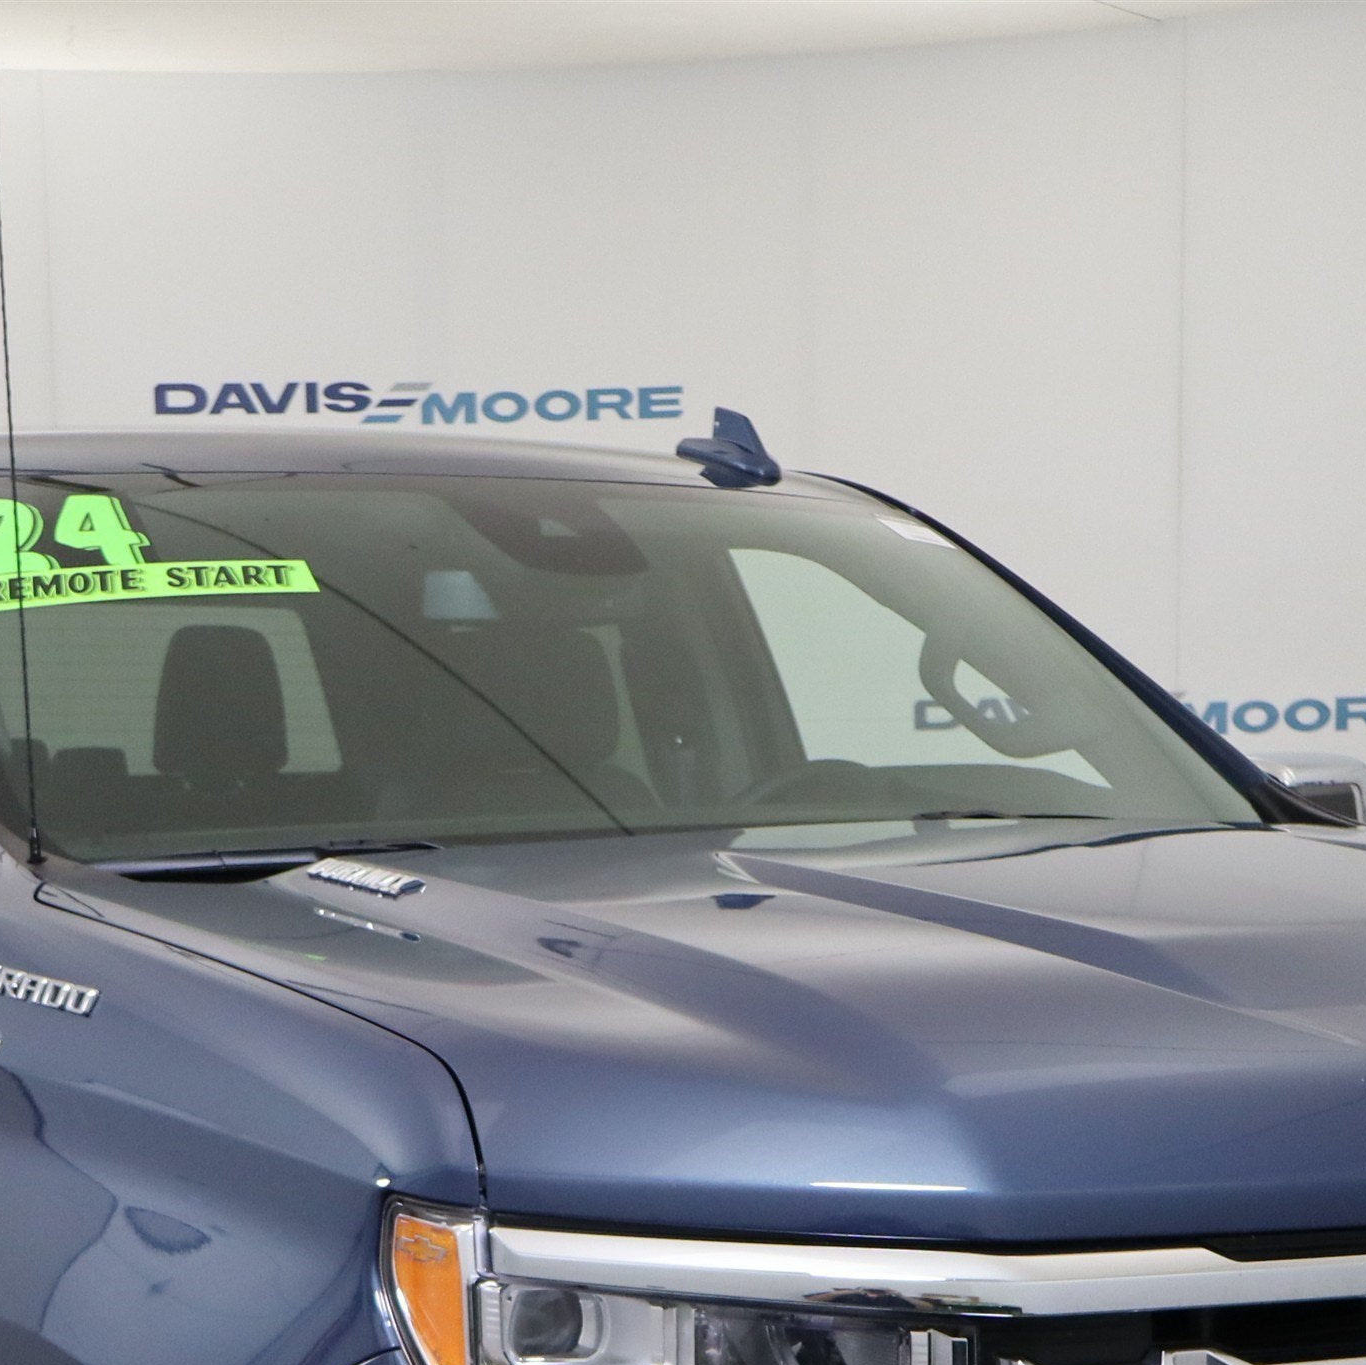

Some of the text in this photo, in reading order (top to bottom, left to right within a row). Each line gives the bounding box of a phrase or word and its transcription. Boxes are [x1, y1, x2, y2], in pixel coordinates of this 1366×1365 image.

[153, 381, 684, 425] DAVIS MOORE
[166, 564, 291, 588] START
